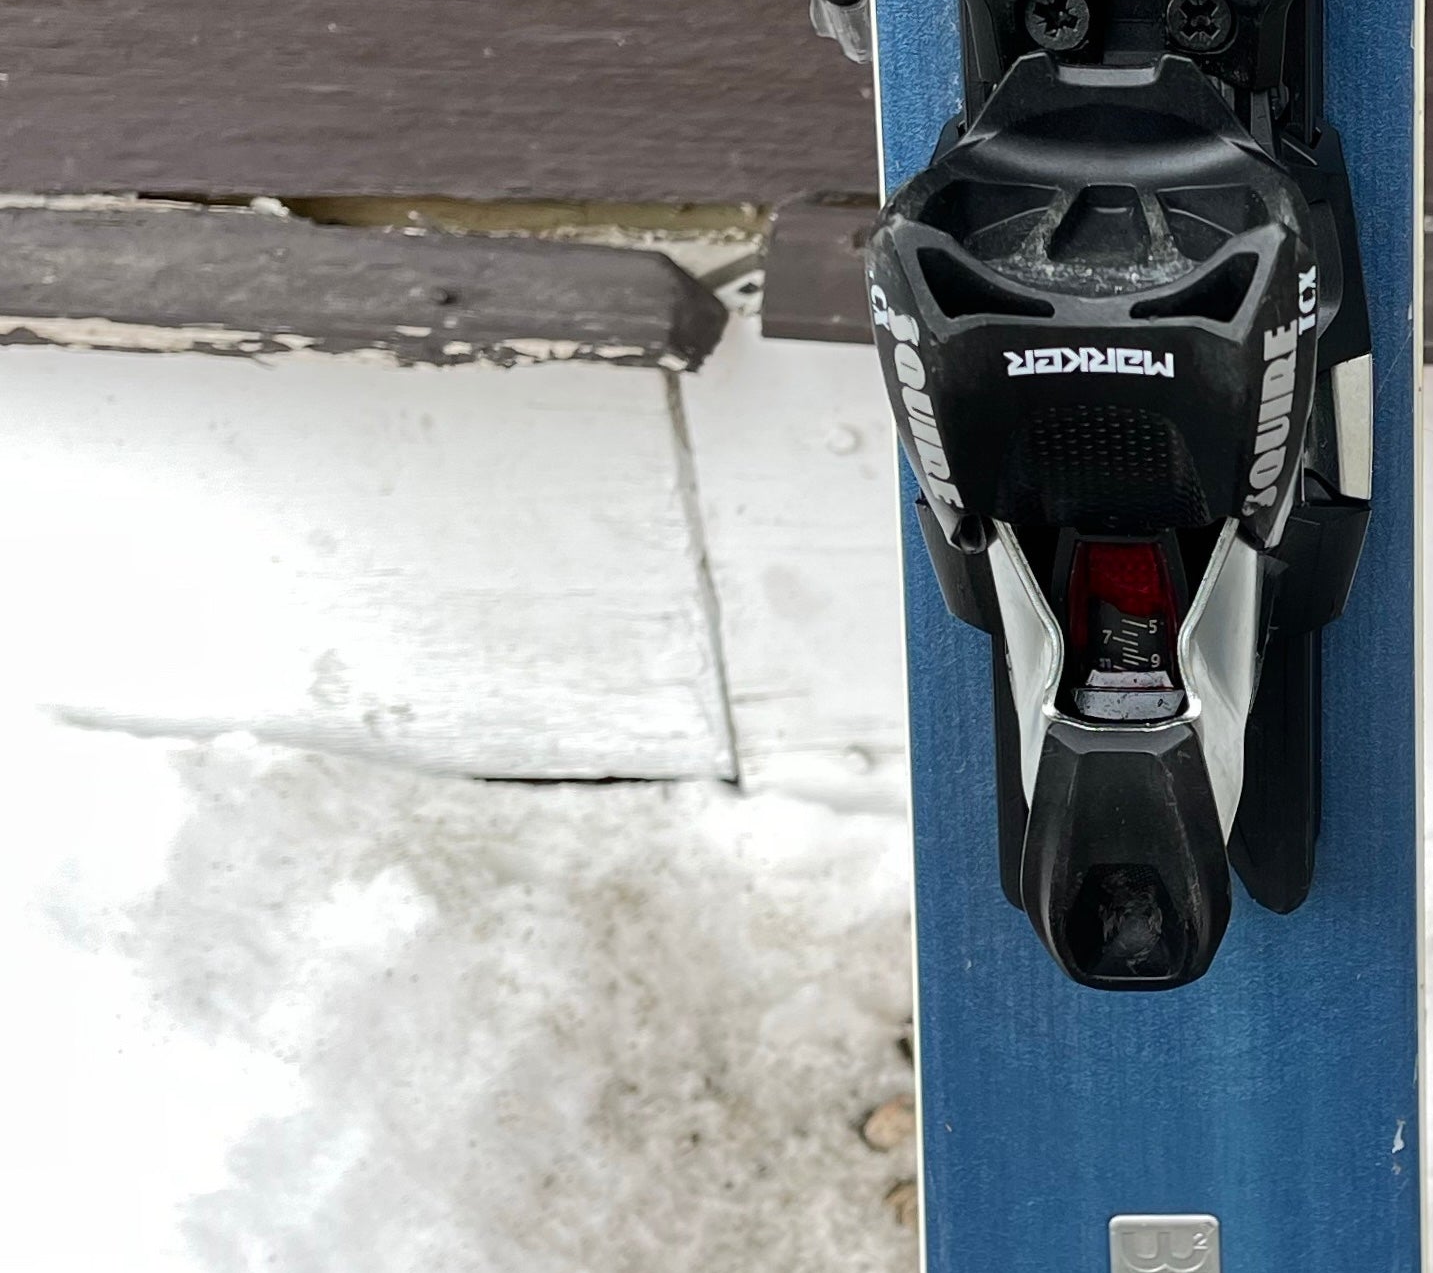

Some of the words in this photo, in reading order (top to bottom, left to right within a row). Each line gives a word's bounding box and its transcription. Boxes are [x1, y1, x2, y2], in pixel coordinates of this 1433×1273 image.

[869, 271, 890, 331] CX
[1002, 347, 1175, 378] MARKER
[888, 309, 964, 509] SQUIRE
[1241, 319, 1298, 517] SQUIRE
[1102, 629, 1113, 644] 7
[1148, 619, 1158, 634] 5
[1150, 653, 1161, 668] 9
